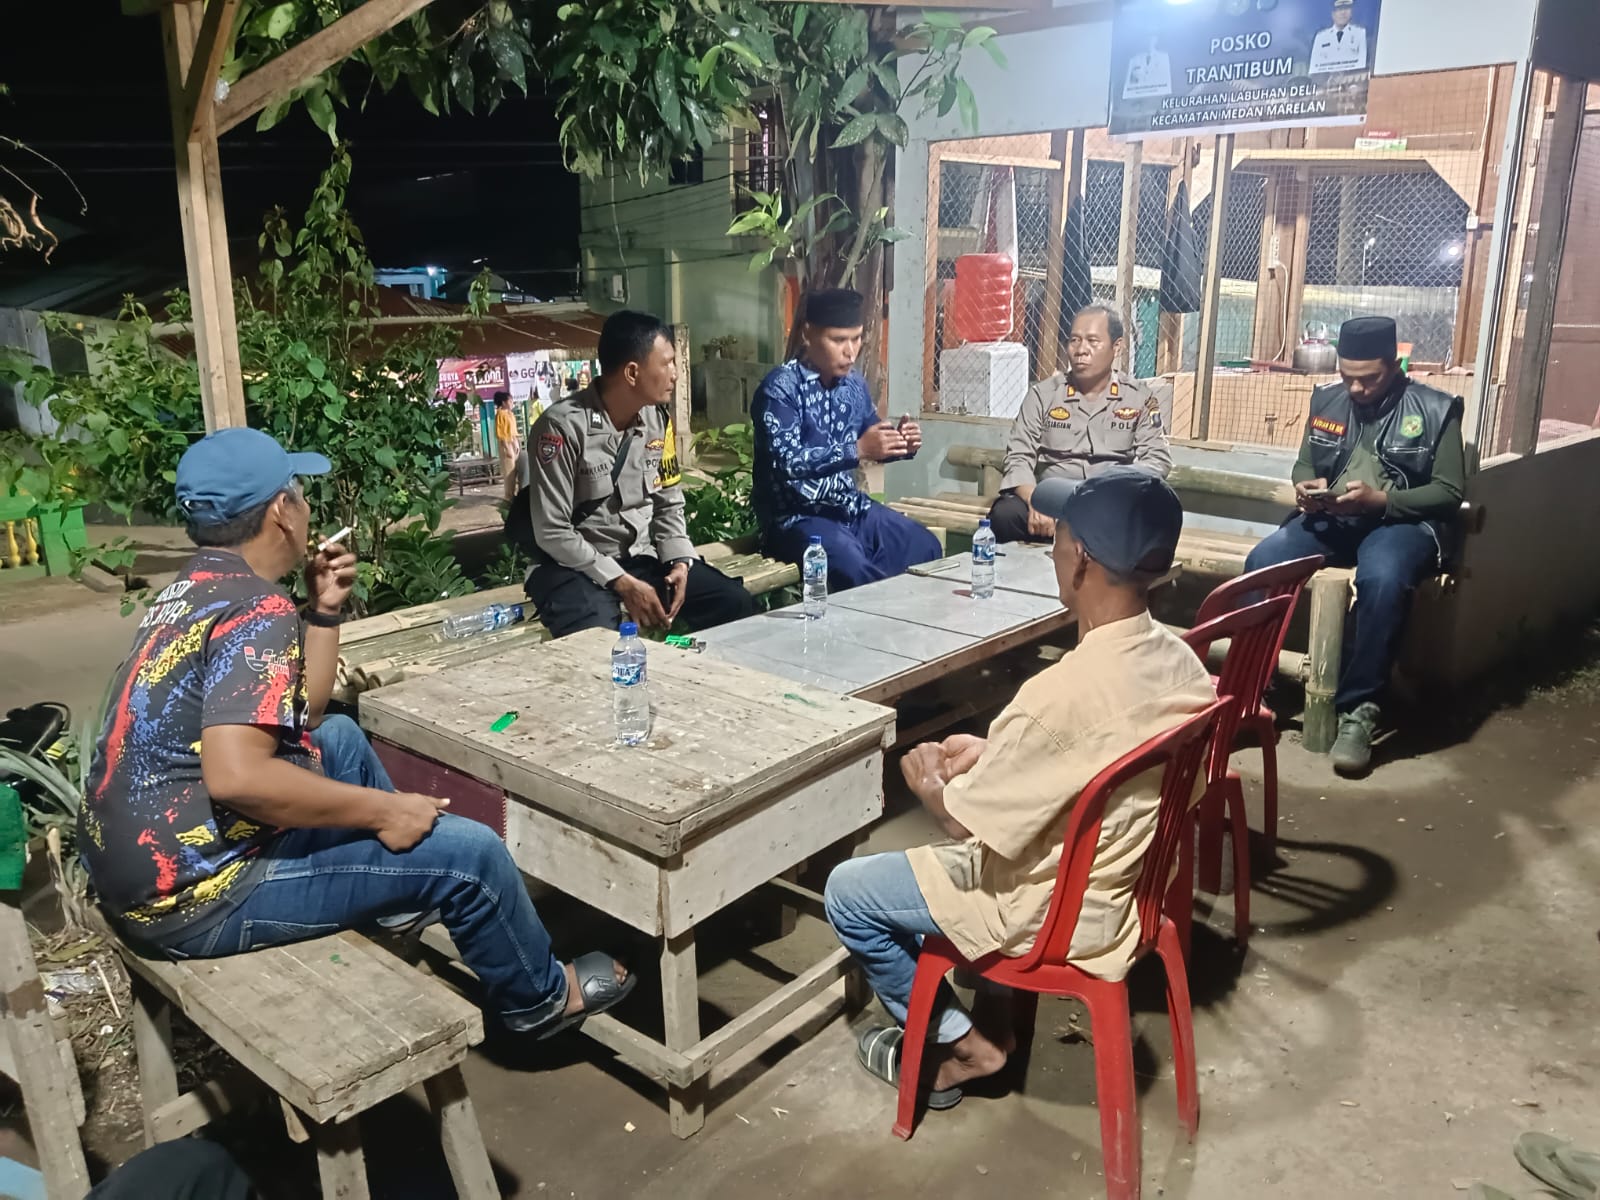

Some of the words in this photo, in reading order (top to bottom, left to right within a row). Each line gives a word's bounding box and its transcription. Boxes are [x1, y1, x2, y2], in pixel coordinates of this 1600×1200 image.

[1210, 31, 1271, 54] POSKO
[1186, 57, 1293, 84] TRANTIBUM
[1162, 93, 1228, 109] KELURAHAN
[1231, 87, 1287, 103] LABUHAN
[1152, 110, 1219, 126] KECAMATAN
[1221, 105, 1264, 120] MEDAN
[1266, 100, 1326, 116] MARELAN
[1111, 421, 1132, 430] POL
